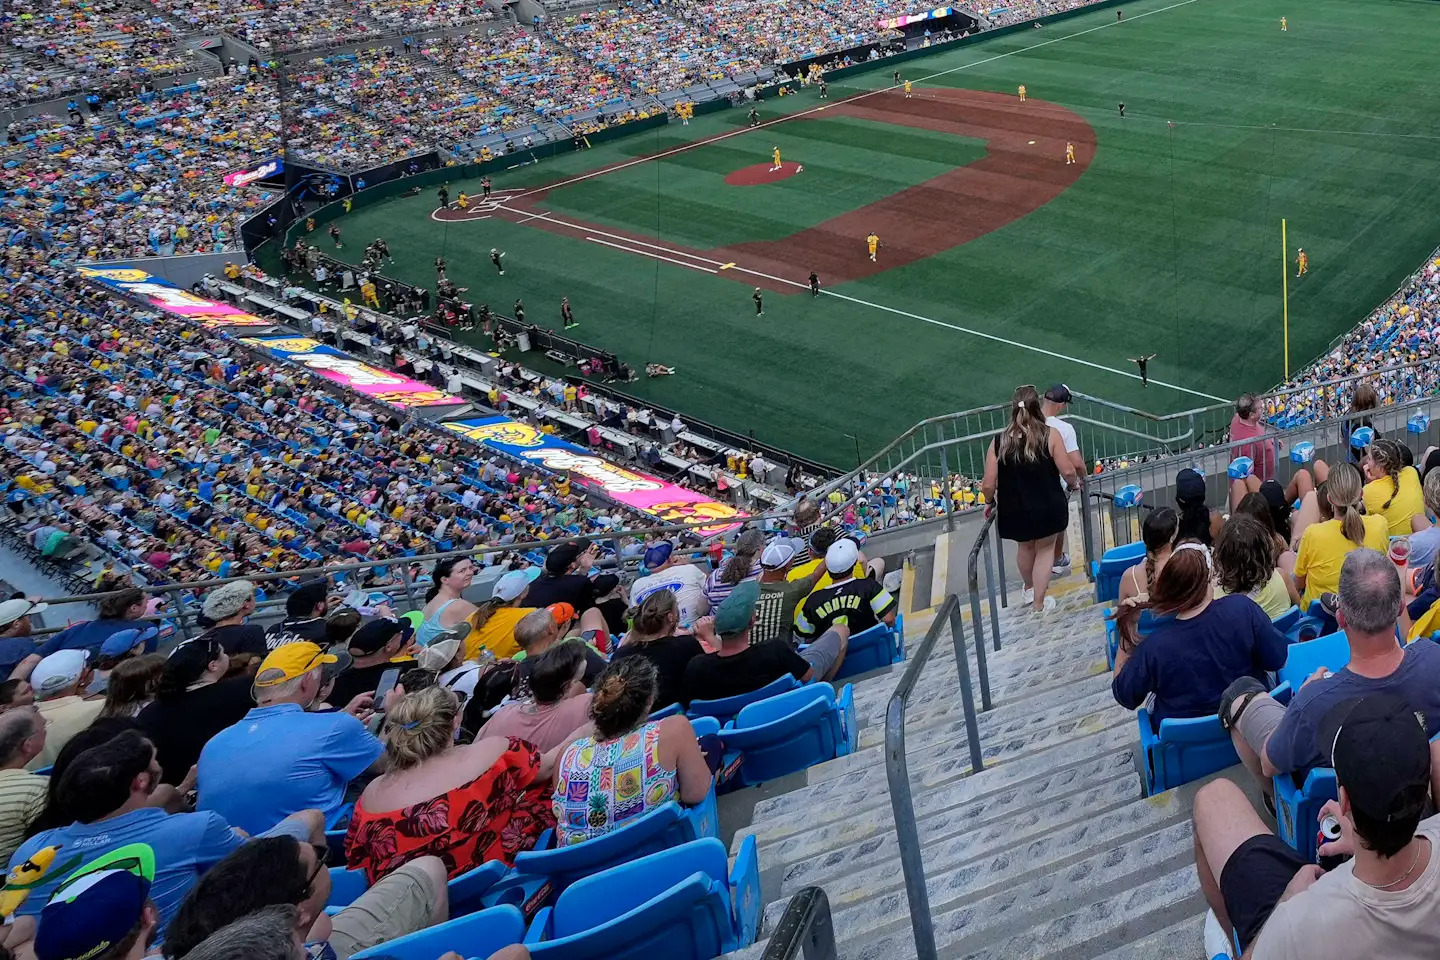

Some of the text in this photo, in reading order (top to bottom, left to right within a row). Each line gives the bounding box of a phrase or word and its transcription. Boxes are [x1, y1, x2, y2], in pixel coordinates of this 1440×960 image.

[757, 591, 784, 600] EDOM
[815, 594, 861, 619] NGUYEN
[81, 838, 111, 847] MILLAR
[84, 834, 109, 843] PETER
